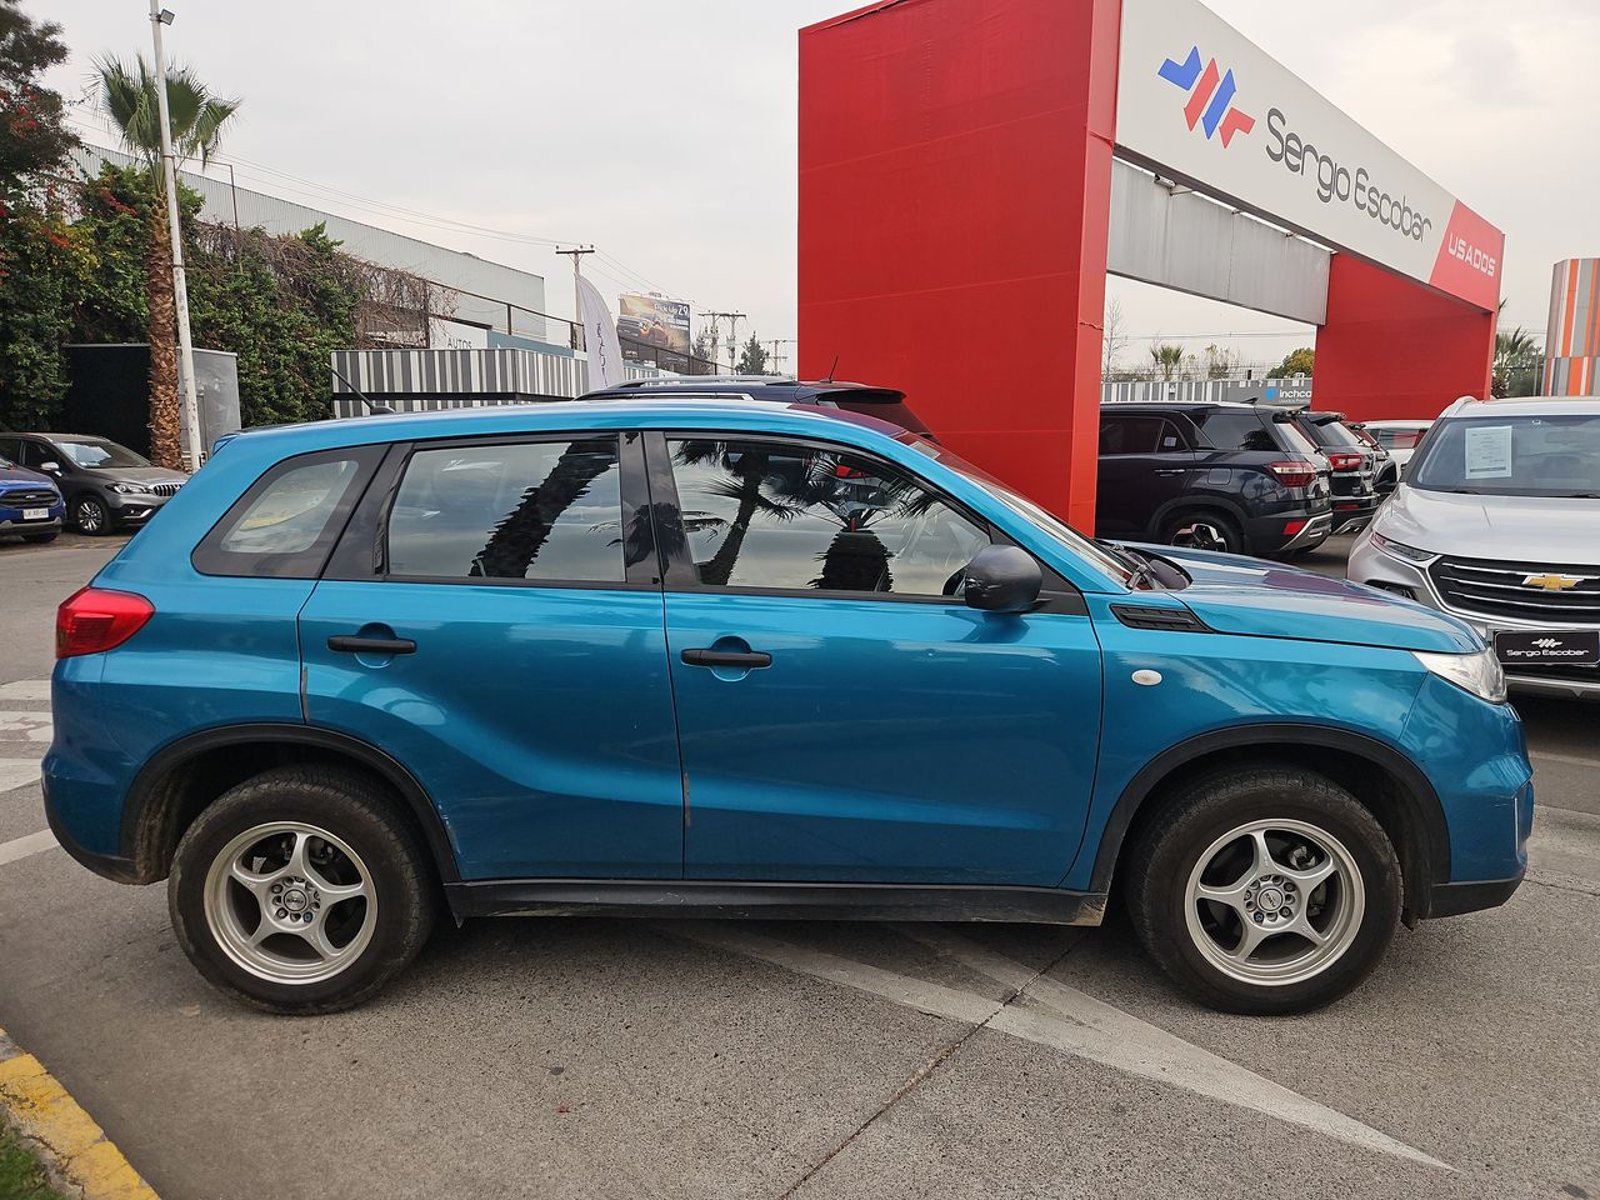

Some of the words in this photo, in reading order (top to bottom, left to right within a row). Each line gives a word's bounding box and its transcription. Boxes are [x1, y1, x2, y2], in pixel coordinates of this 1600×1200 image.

[1354, 167, 1432, 242] Escobar
[1448, 232, 1496, 277] USADOS
[447, 337, 472, 349] AUTOS
